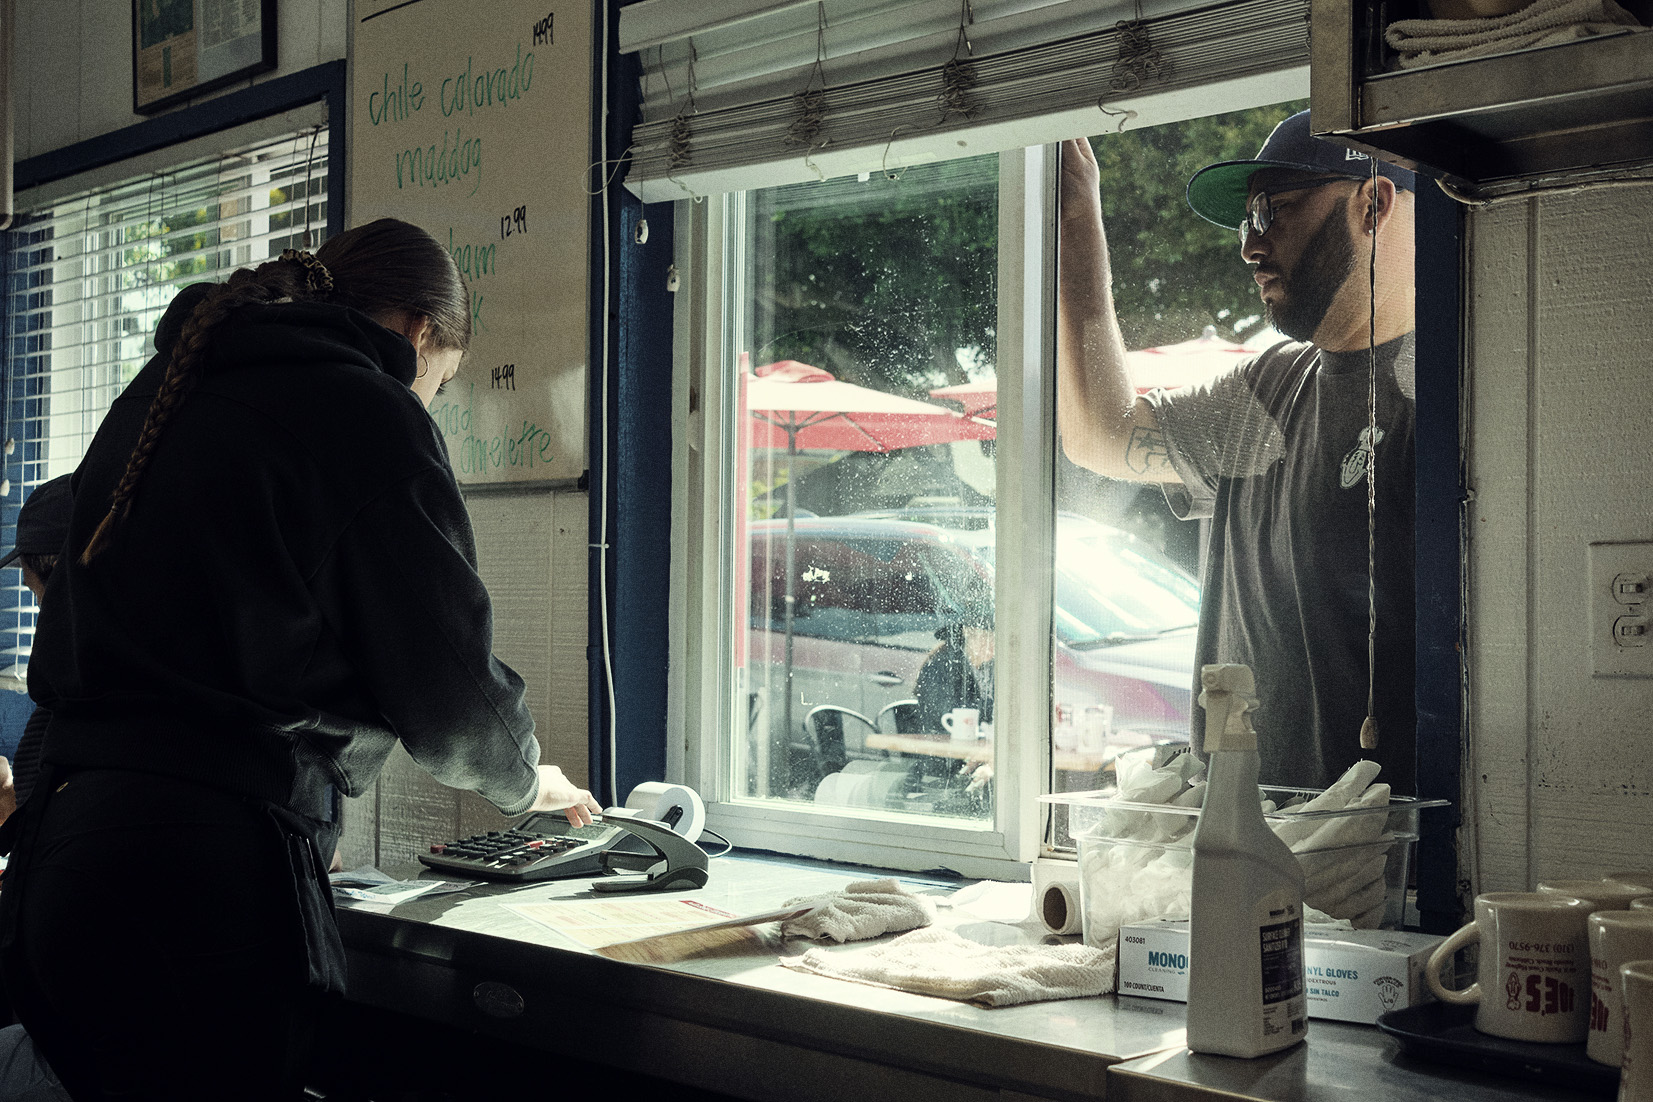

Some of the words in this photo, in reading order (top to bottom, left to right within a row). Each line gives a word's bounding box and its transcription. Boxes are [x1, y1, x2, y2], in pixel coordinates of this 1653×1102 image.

[369, 62, 426, 126] chile
[440, 42, 535, 118] colorado
[500, 205, 527, 241] 12.99
[491, 363, 516, 391] 14.99
[1124, 936, 1146, 944] 403081
[1148, 950, 1188, 970] MONO
[1326, 968, 1358, 980] GLOVES
[1320, 988, 1340, 998] TALCO
